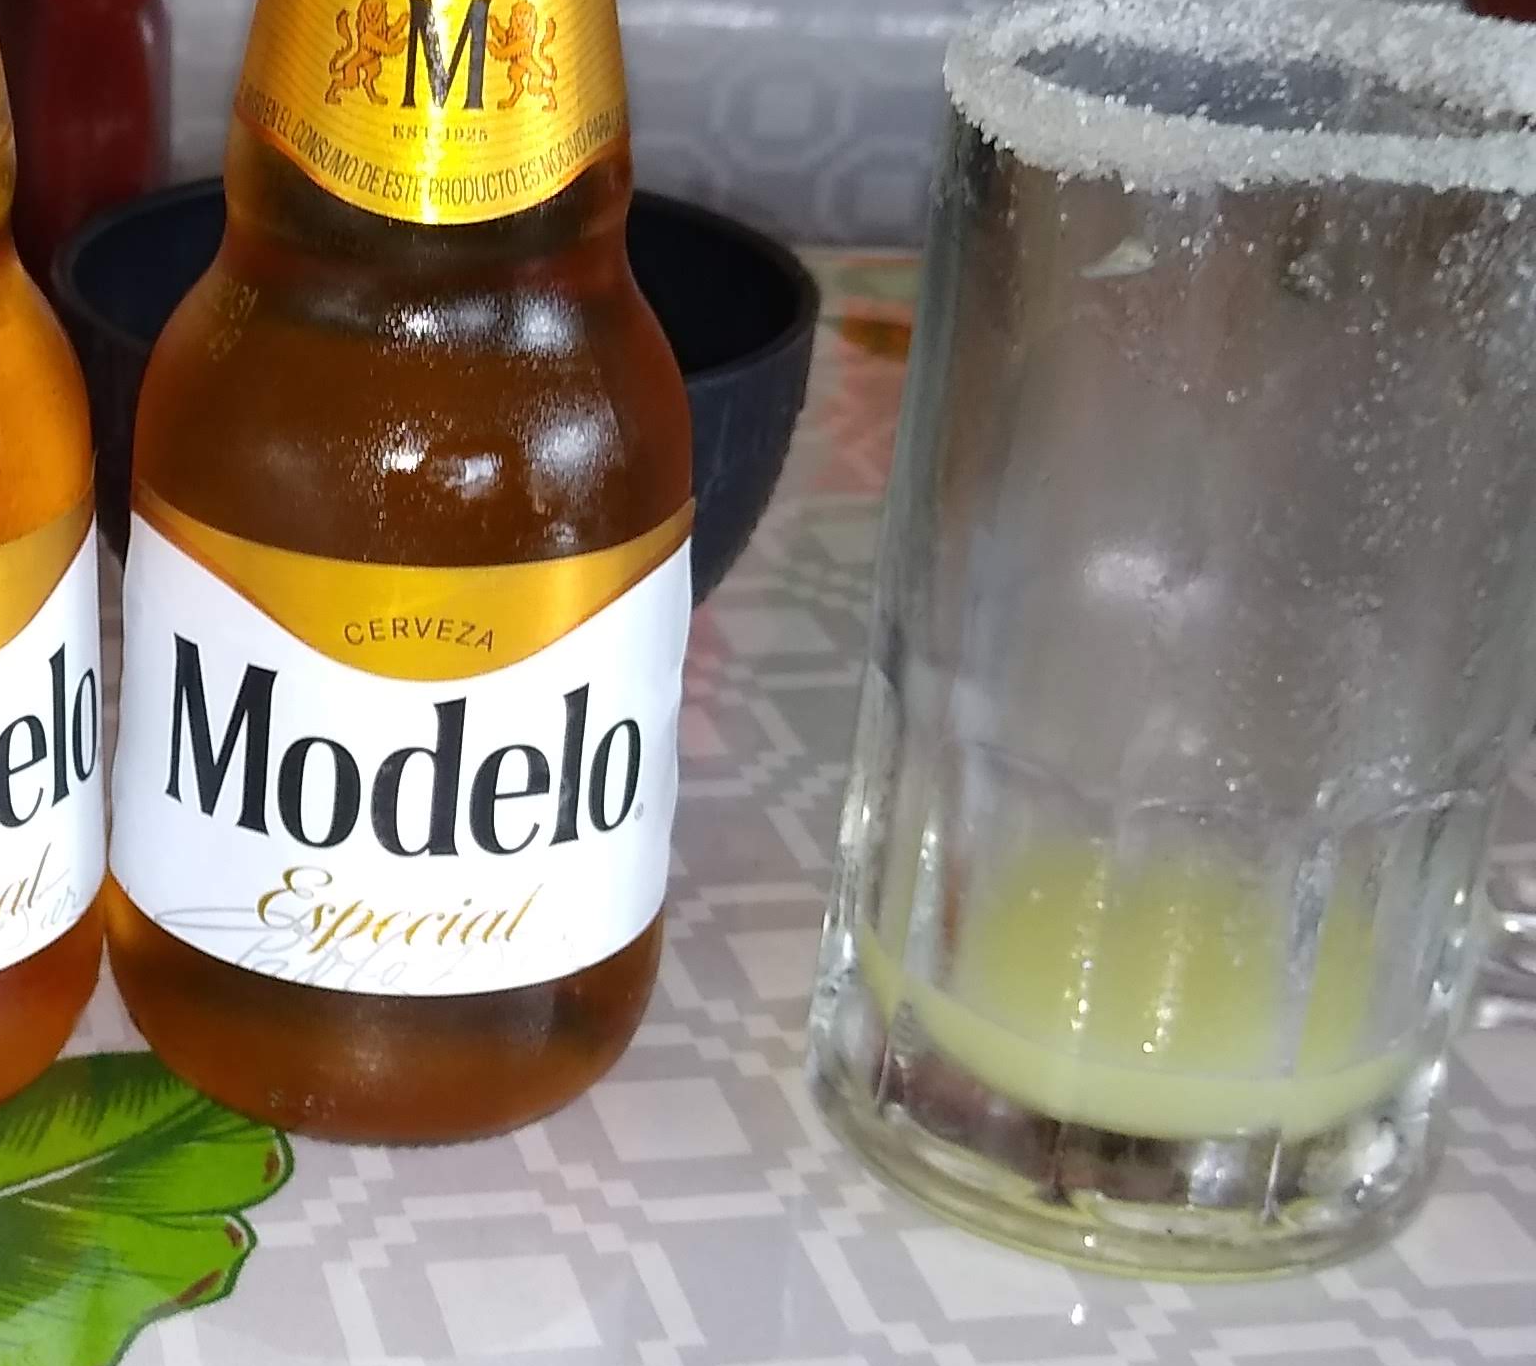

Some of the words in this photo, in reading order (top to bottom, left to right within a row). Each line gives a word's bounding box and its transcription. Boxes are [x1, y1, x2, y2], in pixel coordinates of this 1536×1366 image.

[291, 118, 359, 185] CONSUMO
[357, 160, 381, 195] DE
[381, 166, 423, 203] ESTE
[428, 169, 515, 206] PRODUCTO
[520, 158, 541, 191] ES
[343, 616, 495, 653] CERVEZA
[165, 632, 642, 856] Modelo
[256, 865, 544, 954] Especial
